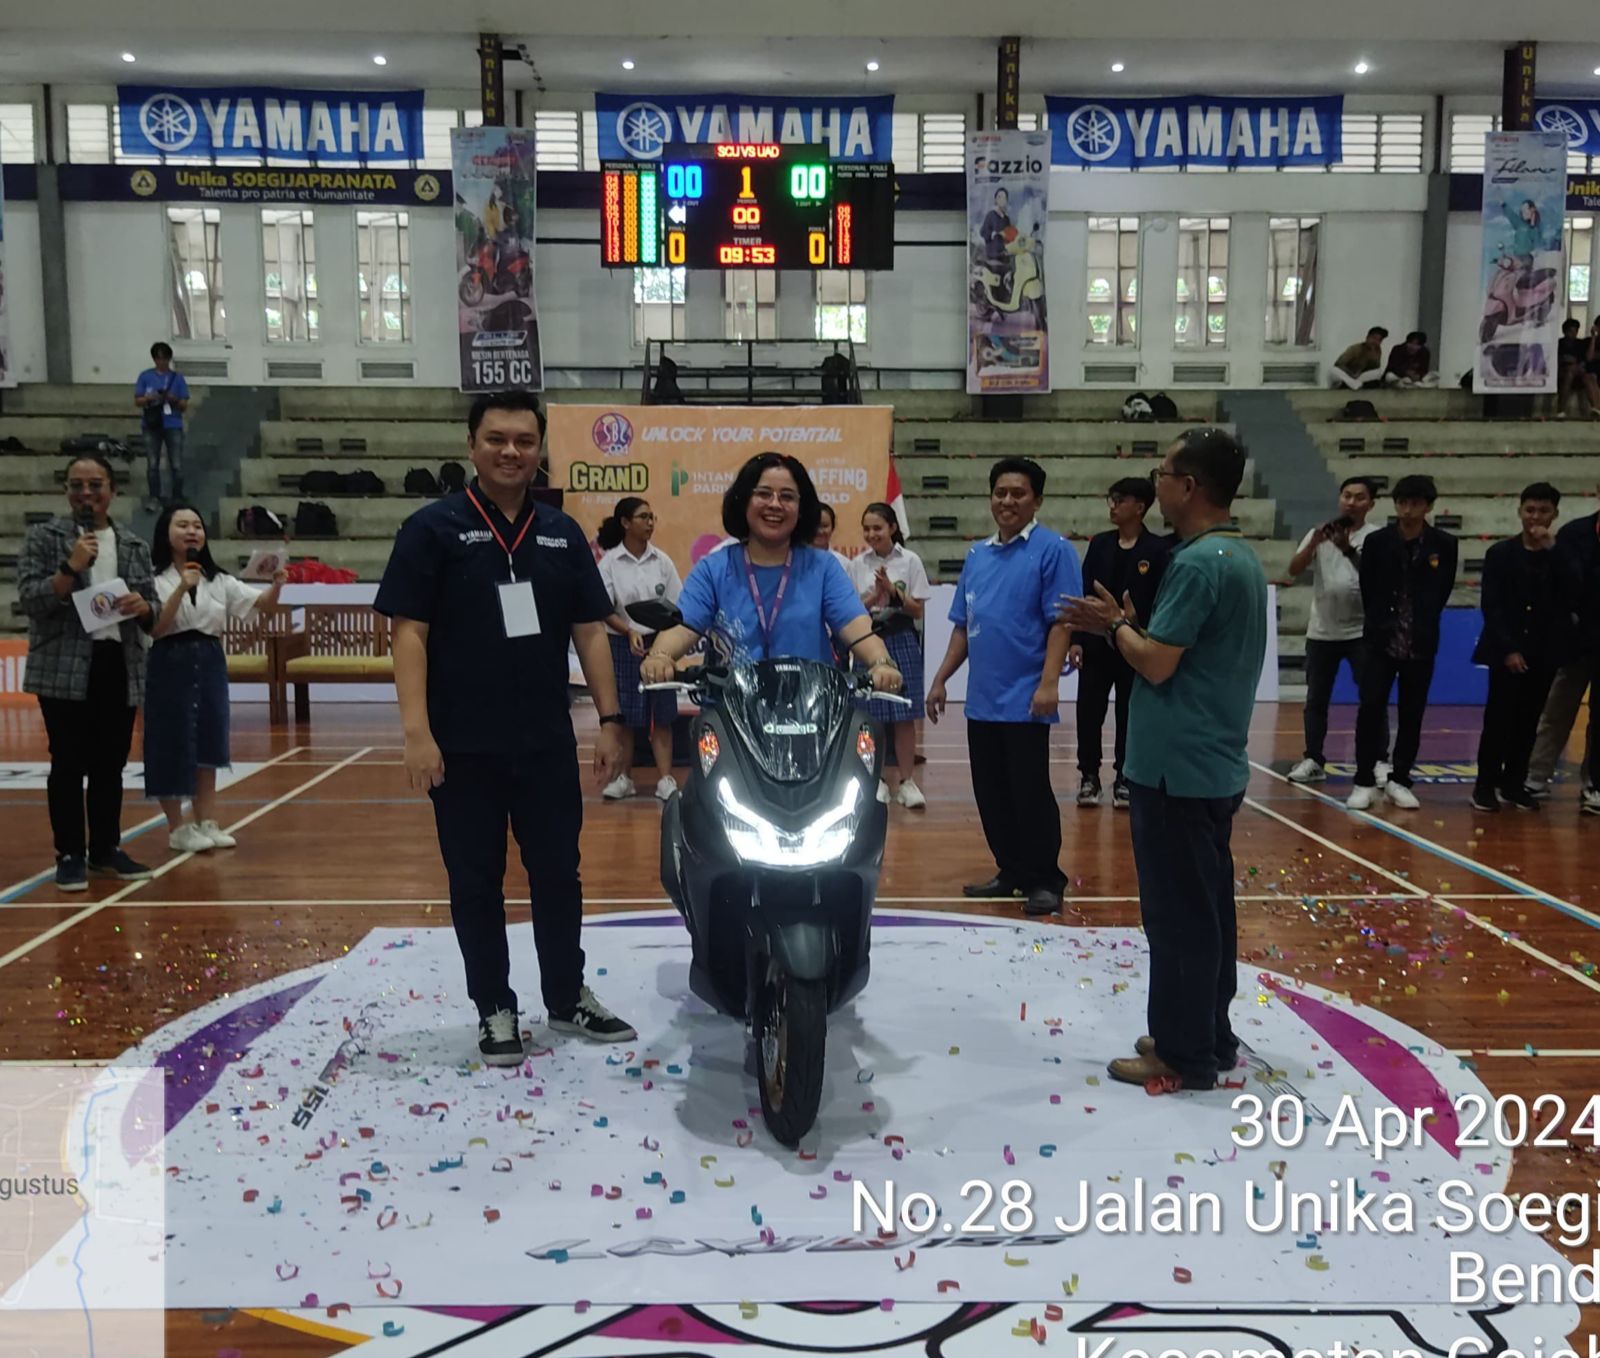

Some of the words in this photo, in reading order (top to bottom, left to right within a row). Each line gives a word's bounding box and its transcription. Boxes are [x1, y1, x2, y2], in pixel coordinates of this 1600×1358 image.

[202, 98, 405, 152] YAMAHA
[676, 104, 873, 157] YAMAHA
[1125, 105, 1323, 158] YAMAHA
[740, 145, 756, 158] VS
[974, 154, 1043, 174] Fazzio
[176, 171, 227, 187] Unika
[232, 172, 396, 189] SOEGIJAPRANATA
[668, 165, 702, 198] 00
[739, 167, 755, 198] 1
[791, 165, 826, 199] 00
[200, 187, 238, 199] Talenta
[242, 190, 260, 200] pro
[263, 189, 296, 200] patria
[299, 191, 311, 200] et
[314, 190, 375, 201] humanitate
[733, 207, 760, 224] 00
[669, 232, 685, 264] 0
[733, 237, 762, 246] TIMER
[809, 232, 825, 264] 0
[720, 247, 775, 263] 09:53
[472, 361, 505, 384] 155
[509, 361, 532, 384] CC
[641, 427, 707, 442] UNLOCK
[711, 427, 754, 442] YOUR
[759, 426, 843, 443] POTENTIAL
[569, 461, 649, 493] GRAND
[693, 471, 734, 481] INTAN
[774, 664, 801, 673] YAMAHA
